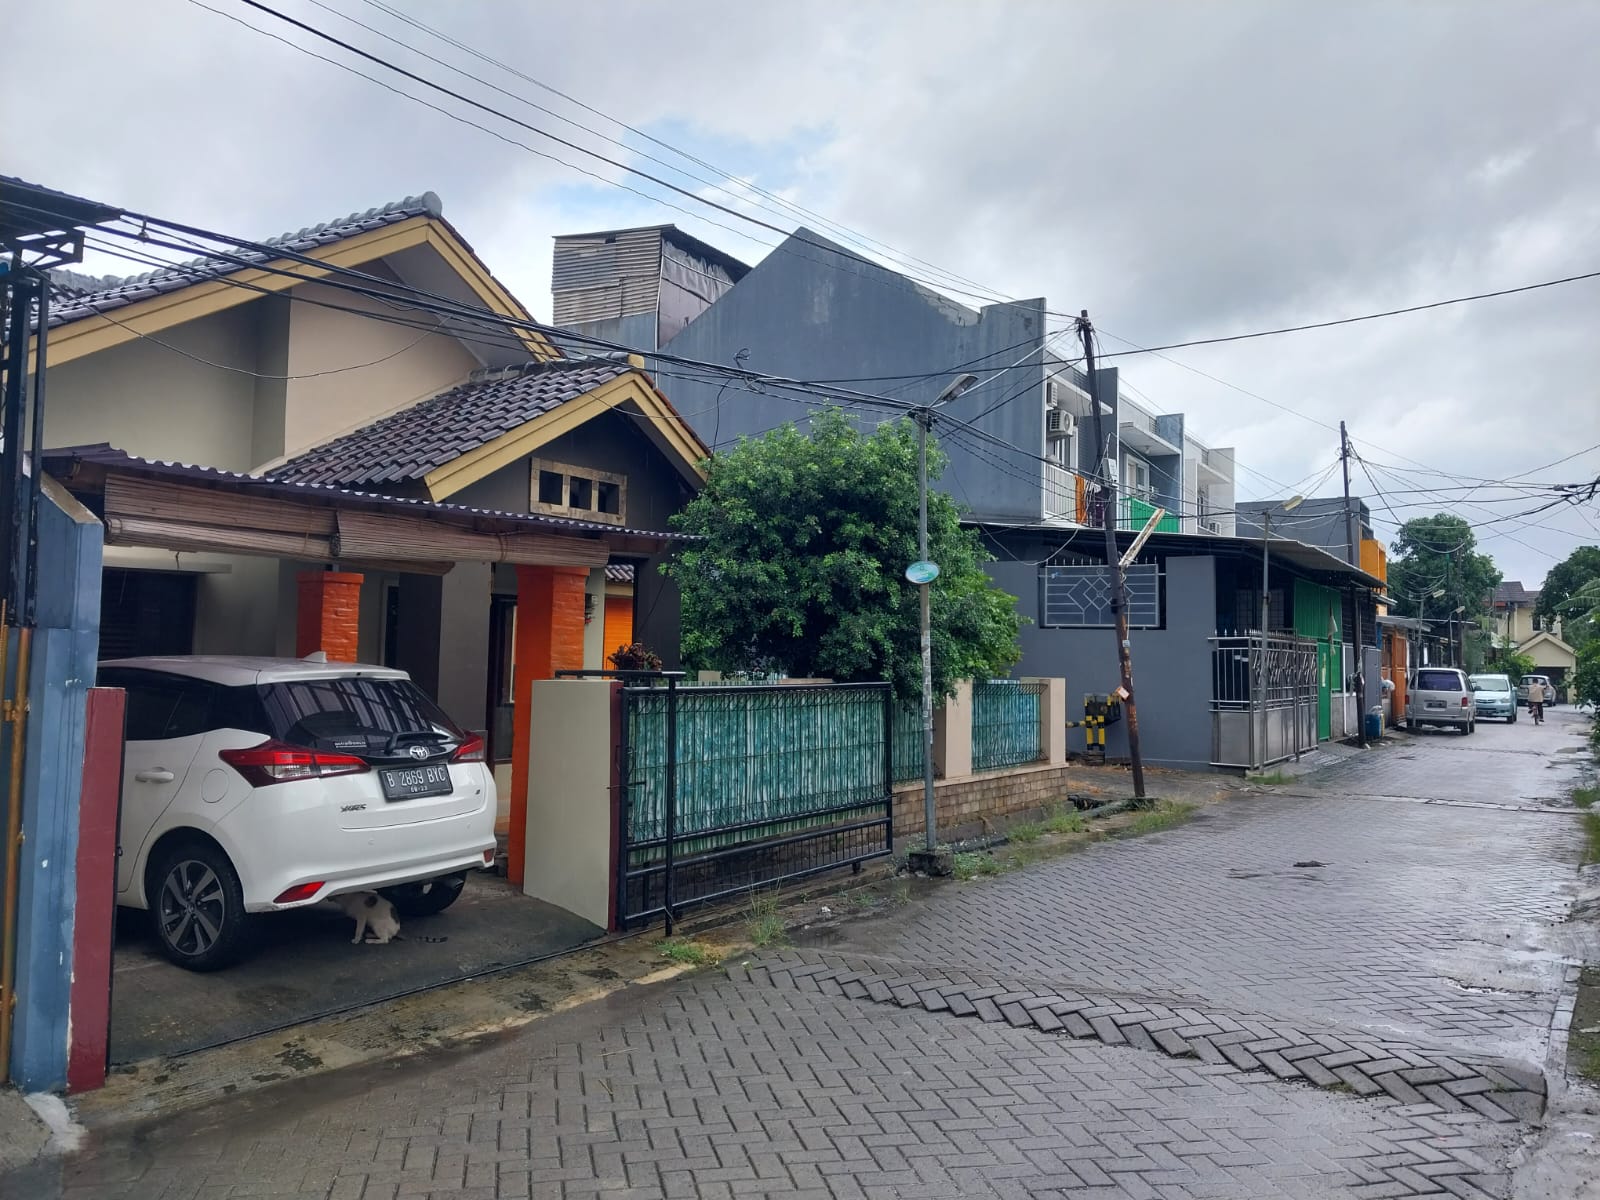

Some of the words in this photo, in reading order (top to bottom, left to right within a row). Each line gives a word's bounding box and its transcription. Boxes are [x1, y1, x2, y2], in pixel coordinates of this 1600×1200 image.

[386, 772, 395, 787] B
[399, 770, 424, 786] 2869
[427, 767, 446, 783] BYC
